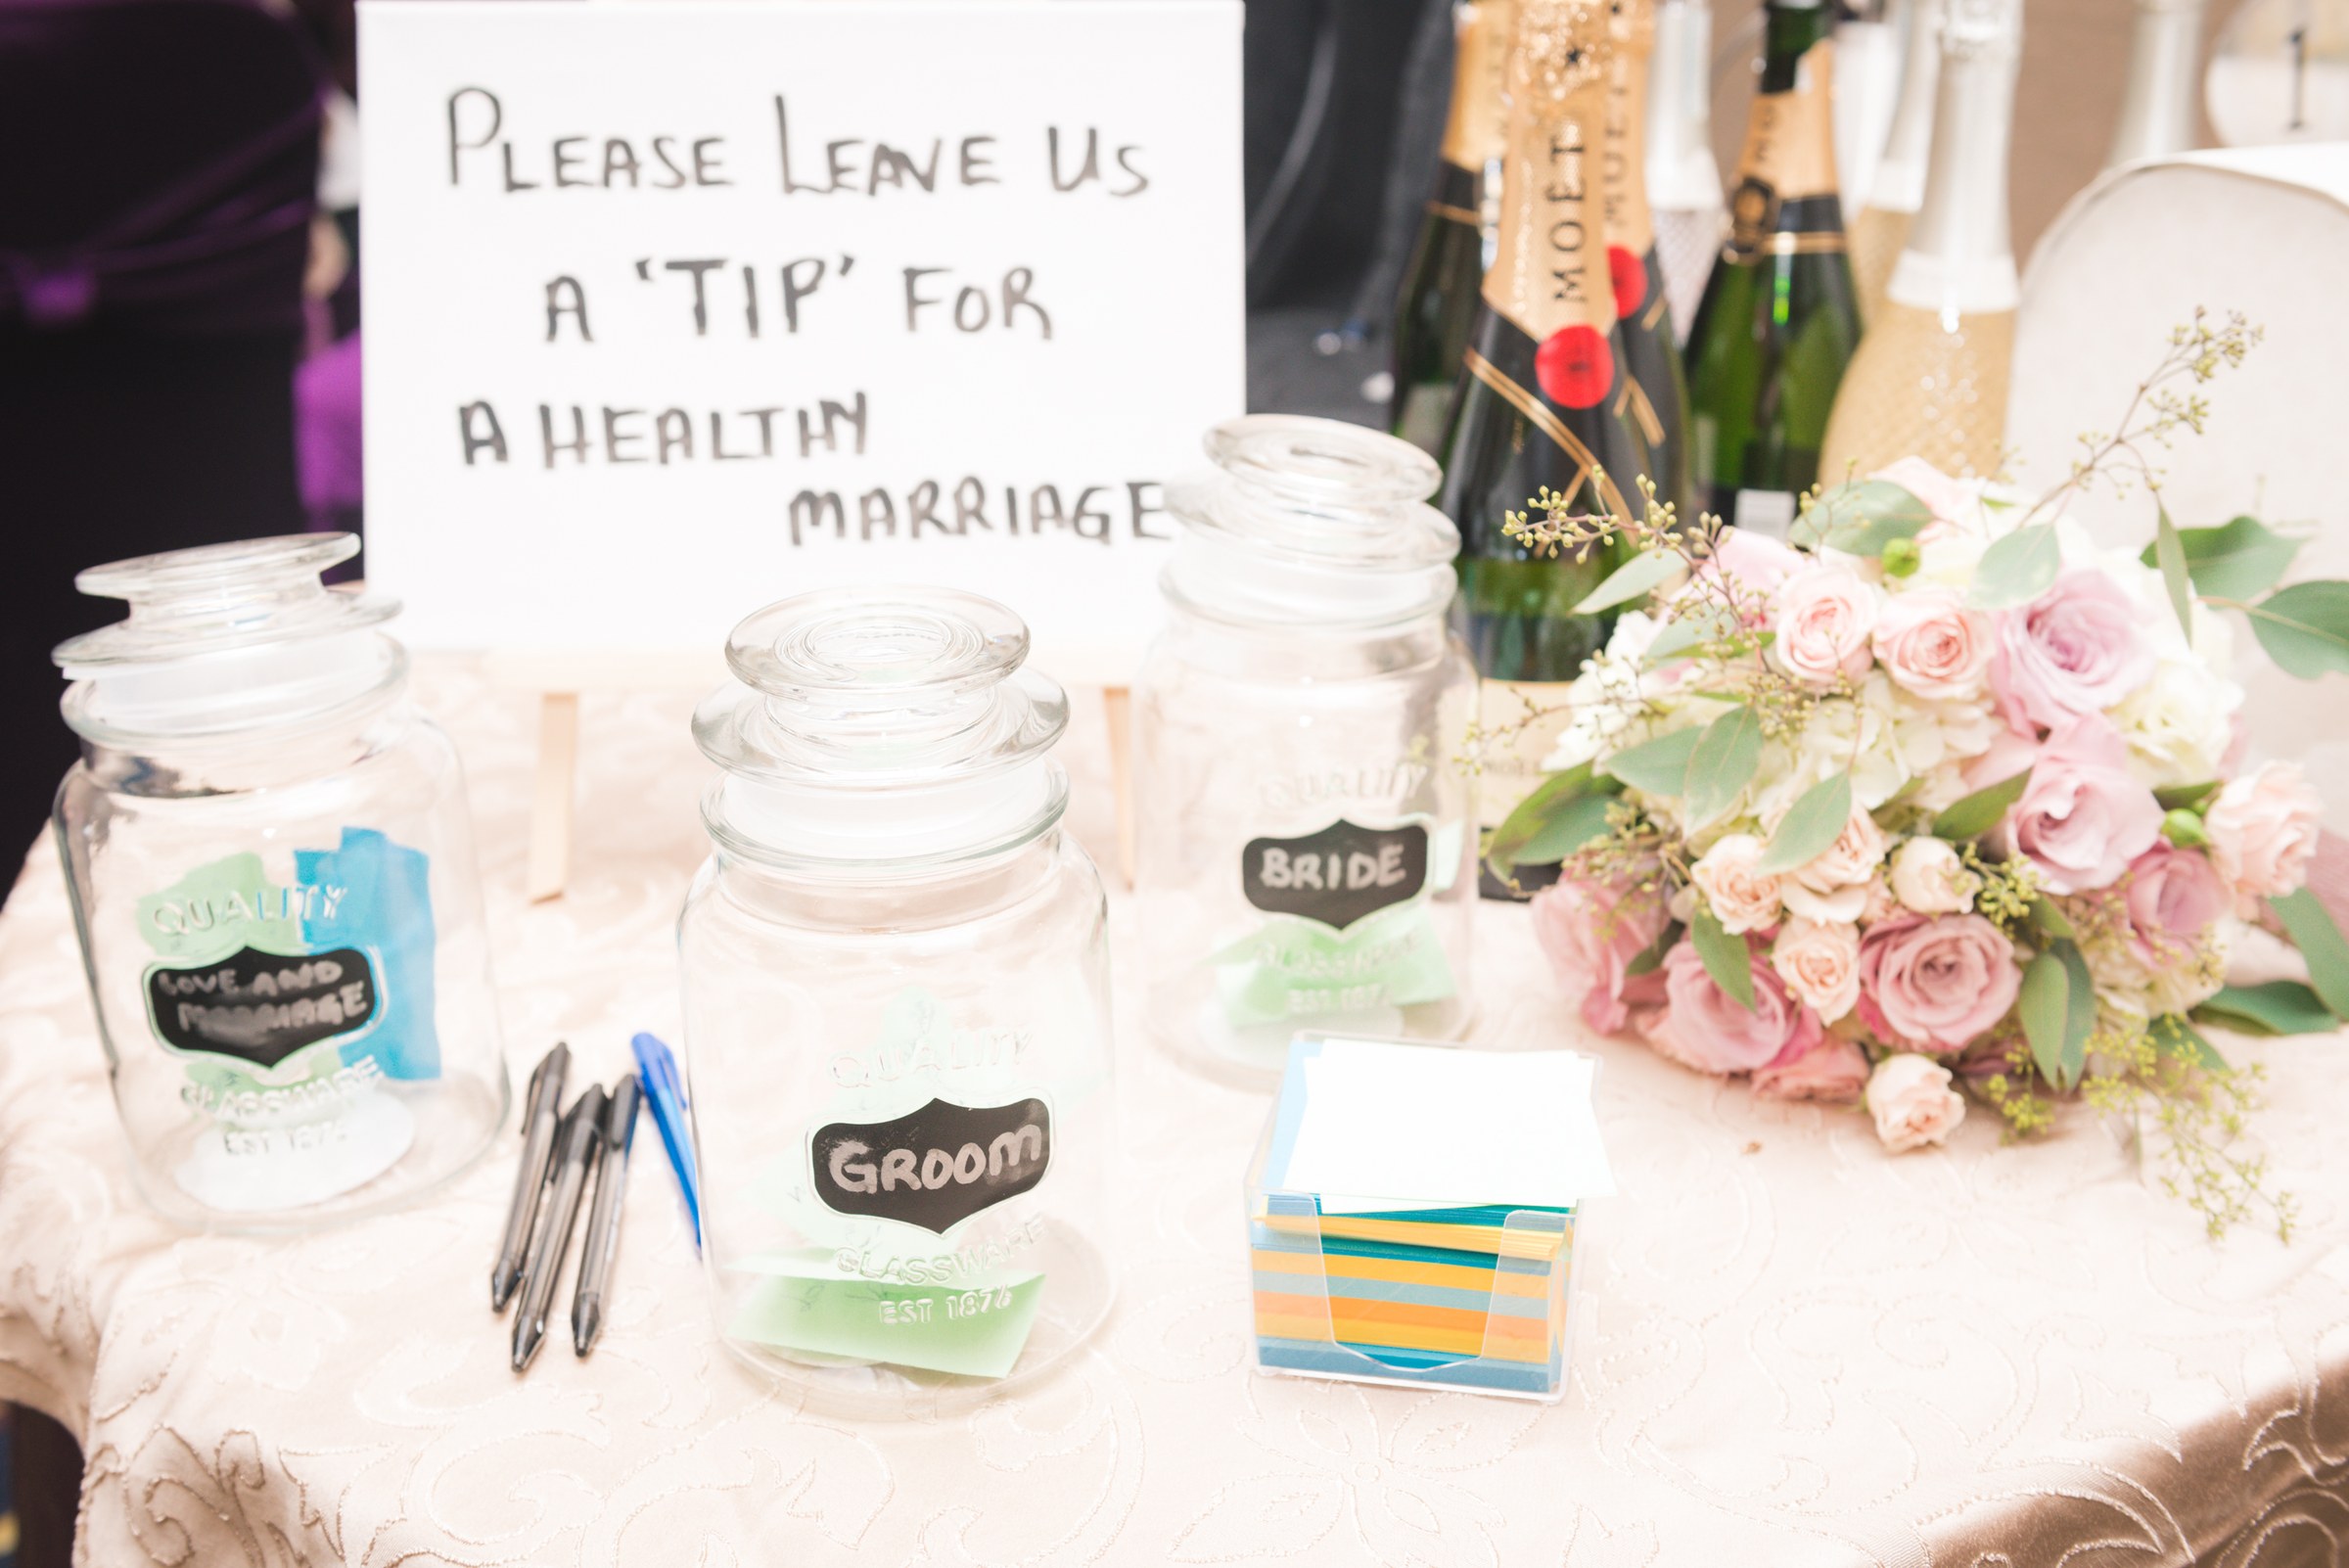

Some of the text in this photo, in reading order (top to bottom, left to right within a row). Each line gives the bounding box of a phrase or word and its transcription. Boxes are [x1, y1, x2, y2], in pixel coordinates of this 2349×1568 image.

[544, 275, 595, 344] A
[902, 266, 1054, 341] FOR
[458, 400, 510, 466] A
[787, 475, 1174, 546] MARRIAGE
[1259, 845, 1406, 891] BRIDE
[153, 884, 347, 936] QUALITY
[157, 960, 344, 996] LOVE AND
[829, 1031, 1034, 1089] QUALITY
[827, 1124, 1042, 1194] GROOM
[834, 1213, 1047, 1285] GLASSWARE
[879, 1299, 935, 1325] EST
